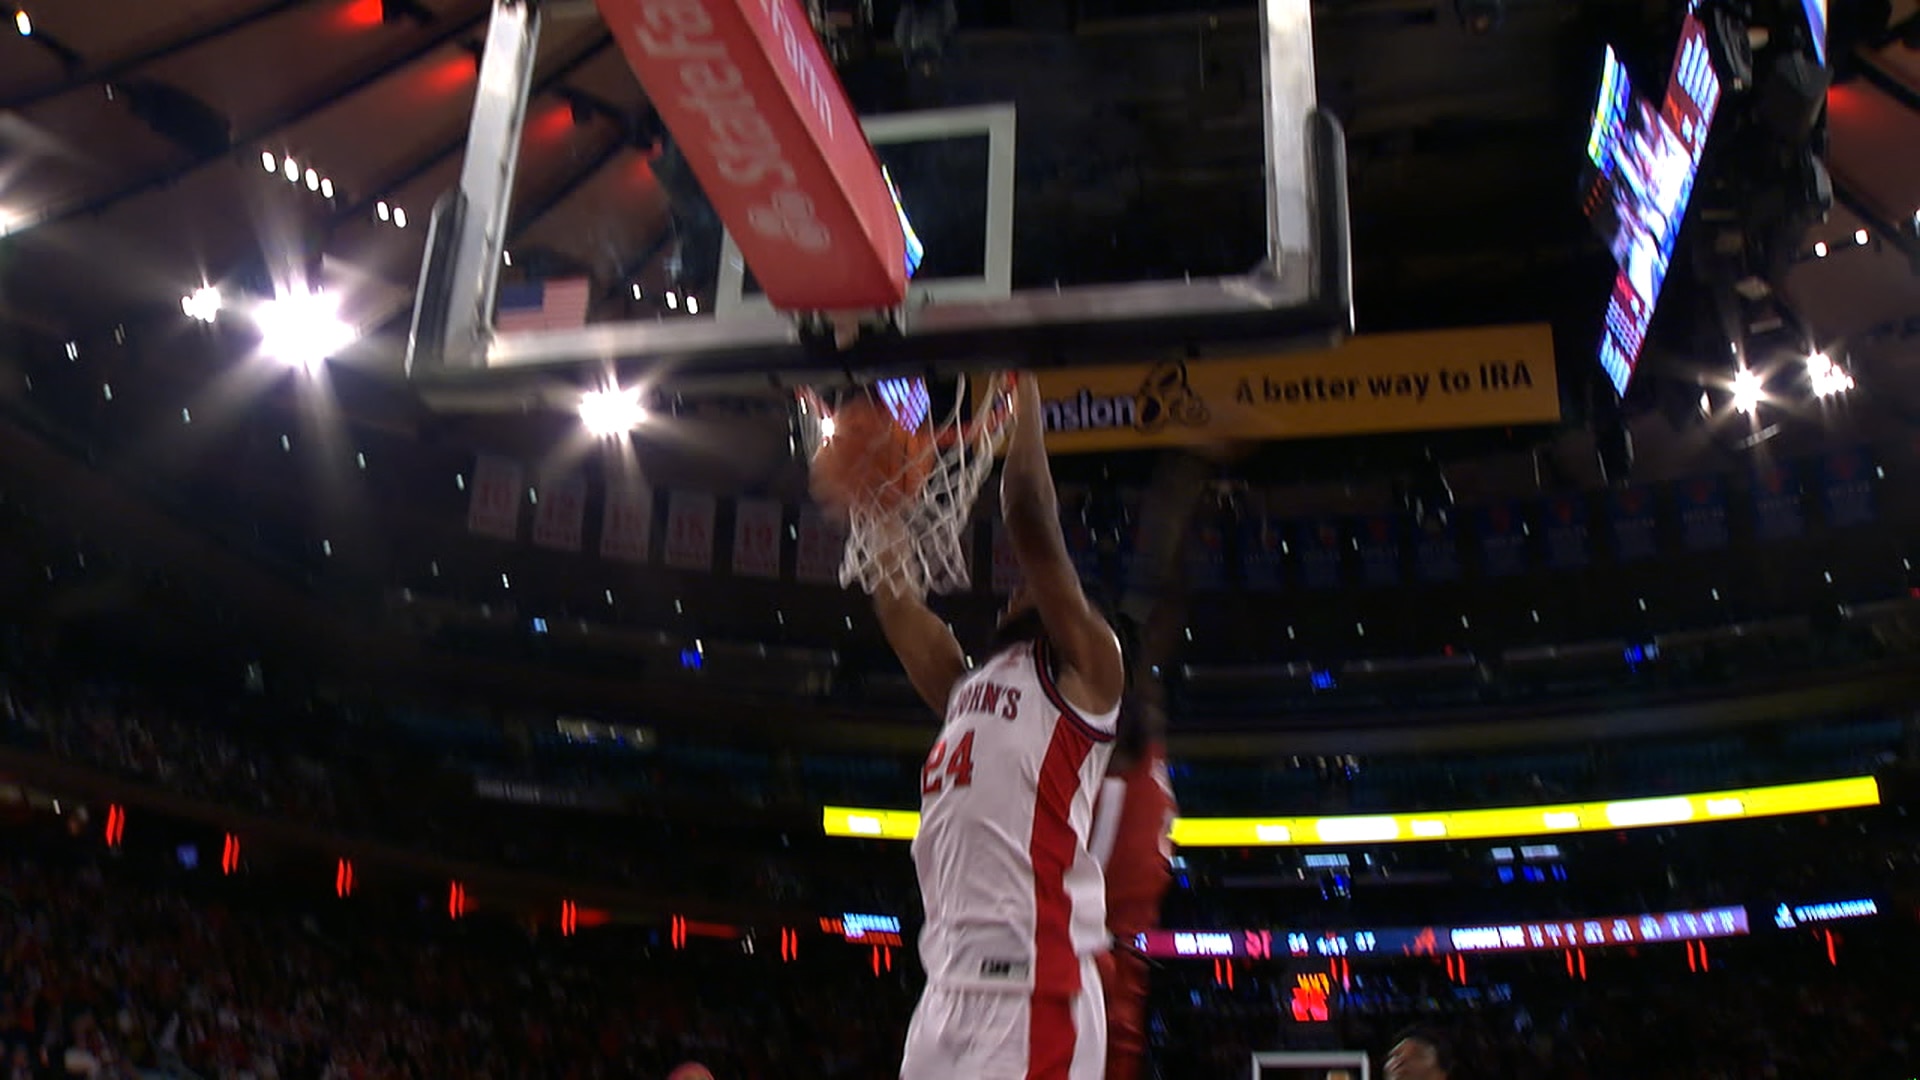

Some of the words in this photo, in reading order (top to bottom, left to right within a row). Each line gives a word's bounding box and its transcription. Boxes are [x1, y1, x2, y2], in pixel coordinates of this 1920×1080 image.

[1236, 378, 1254, 405] A
[1263, 373, 1358, 404] better
[1367, 371, 1429, 406] way
[1439, 367, 1471, 393] to
[1479, 359, 1533, 390] IRA
[1041, 388, 1136, 432] nsion
[922, 728, 975, 795] 24
